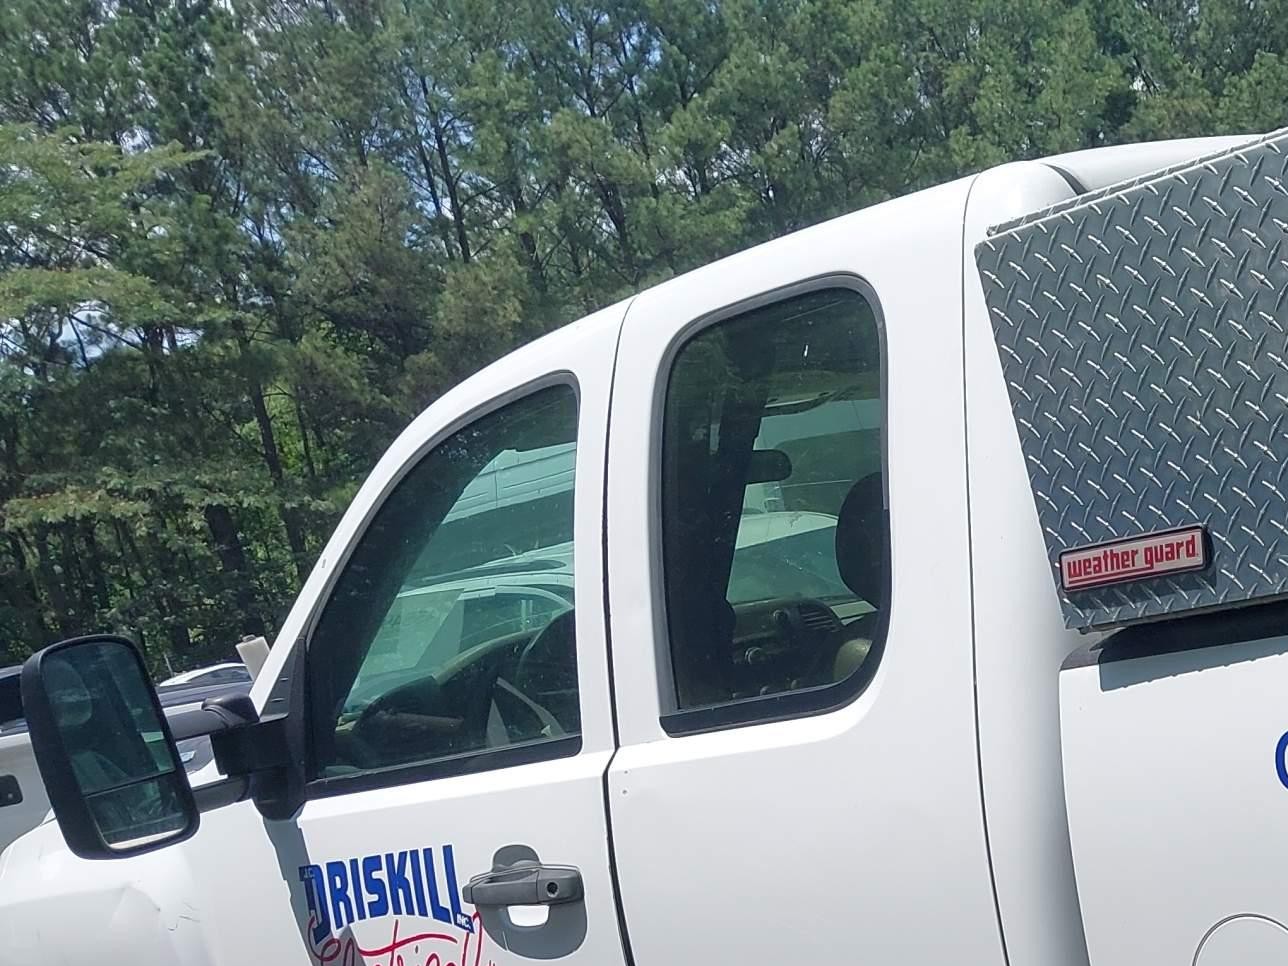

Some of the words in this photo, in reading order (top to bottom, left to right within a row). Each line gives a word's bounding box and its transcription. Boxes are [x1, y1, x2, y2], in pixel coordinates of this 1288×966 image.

[1067, 549, 1139, 578] weather
[1144, 534, 1199, 569] guard
[298, 844, 474, 944] DRISKILL
